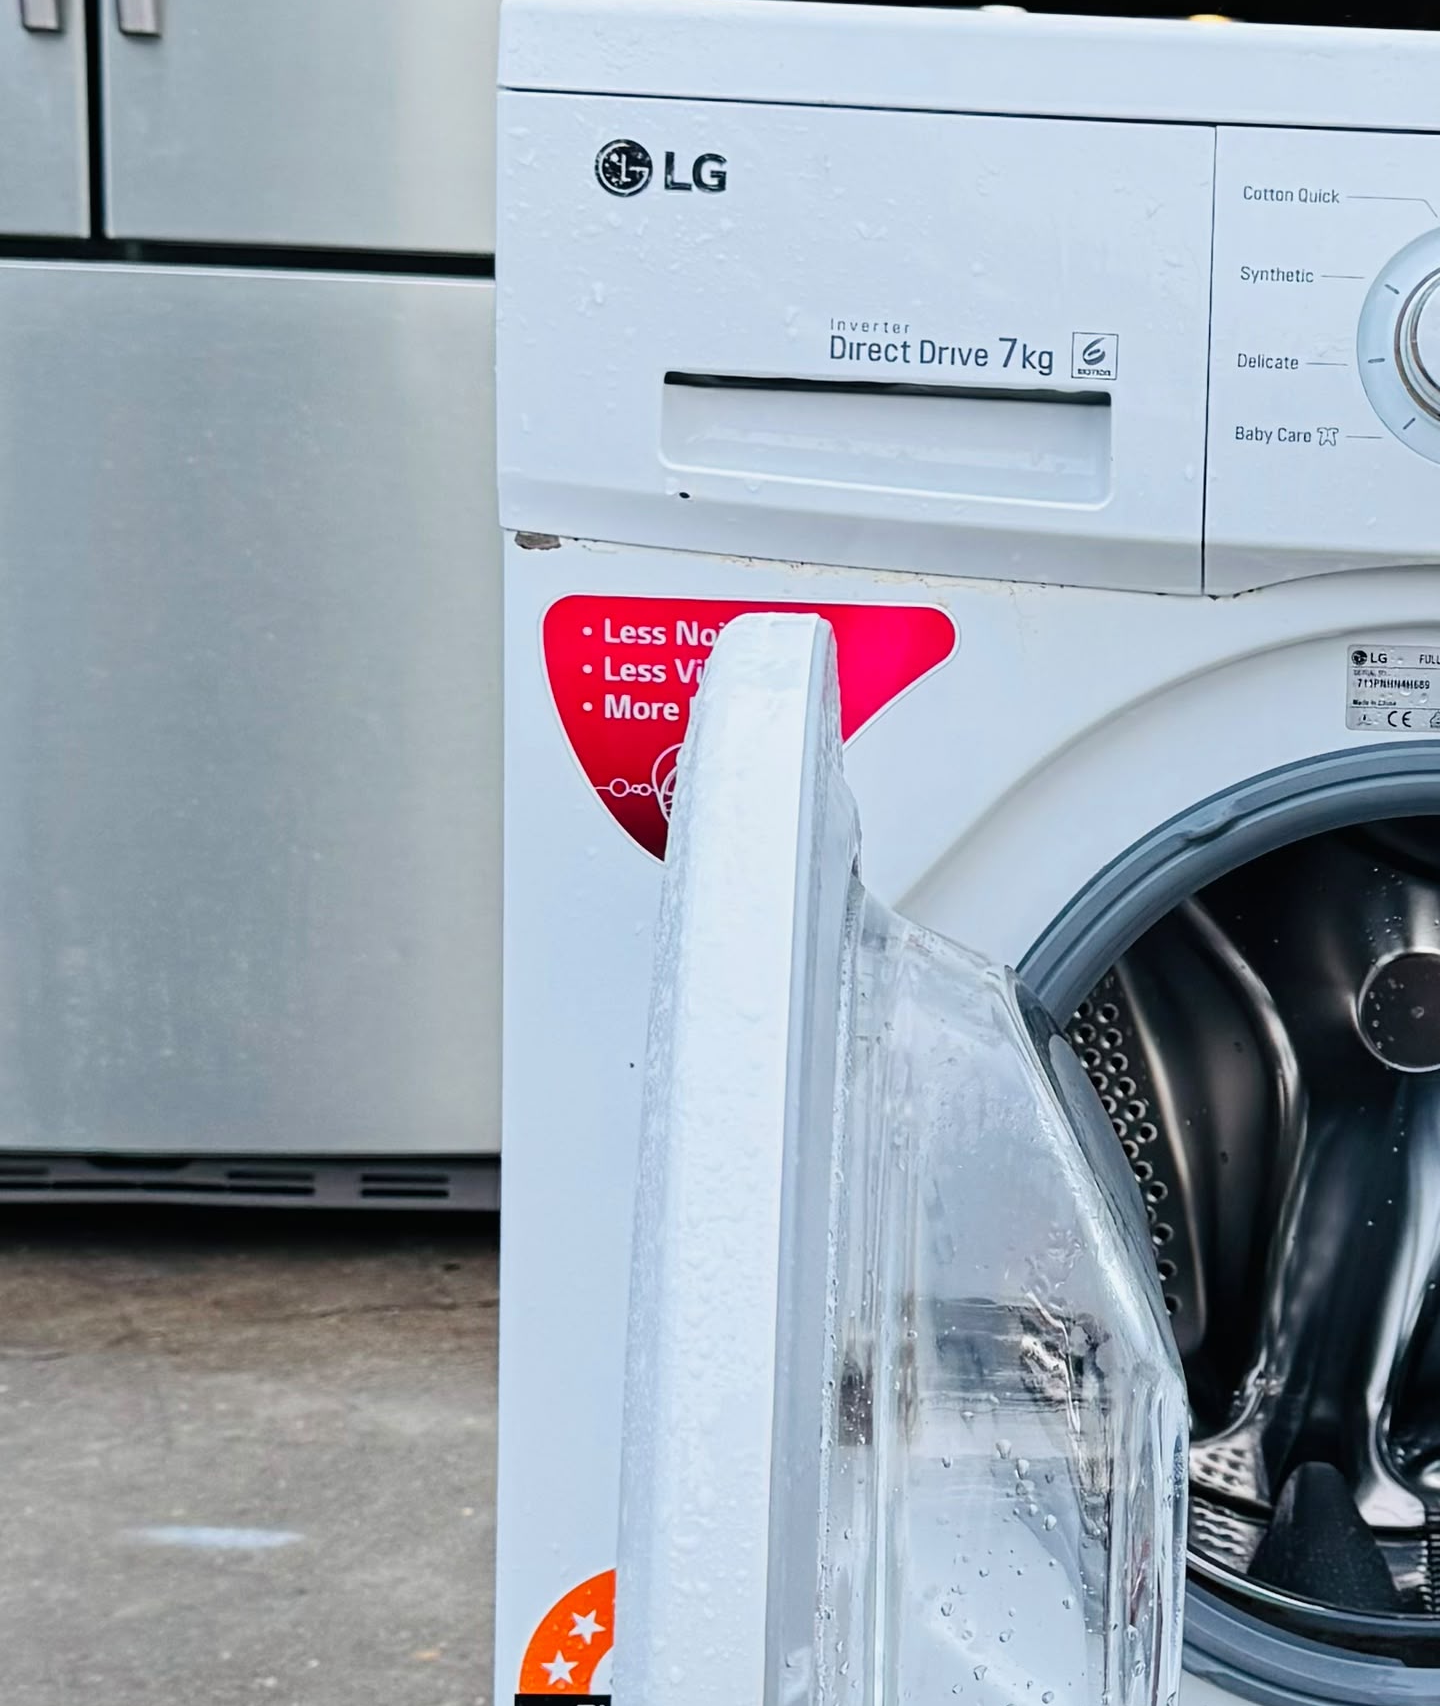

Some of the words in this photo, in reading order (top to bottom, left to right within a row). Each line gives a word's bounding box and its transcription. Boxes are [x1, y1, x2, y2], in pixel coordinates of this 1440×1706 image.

[664, 151, 727, 192] LG
[1243, 185, 1294, 202] Cotton
[1298, 188, 1340, 204] Quick
[1240, 266, 1314, 284] Synthetic
[830, 318, 910, 334] Inverter
[829, 334, 911, 364] Direct
[919, 339, 989, 367] Drive
[1237, 353, 1299, 370] Delicate
[1235, 425, 1273, 445] Baby
[1277, 427, 1312, 443] Care
[604, 618, 667, 645] Less
[676, 620, 726, 647] No
[1370, 652, 1388, 664] LG
[604, 656, 667, 683] Less
[604, 693, 680, 721] More
